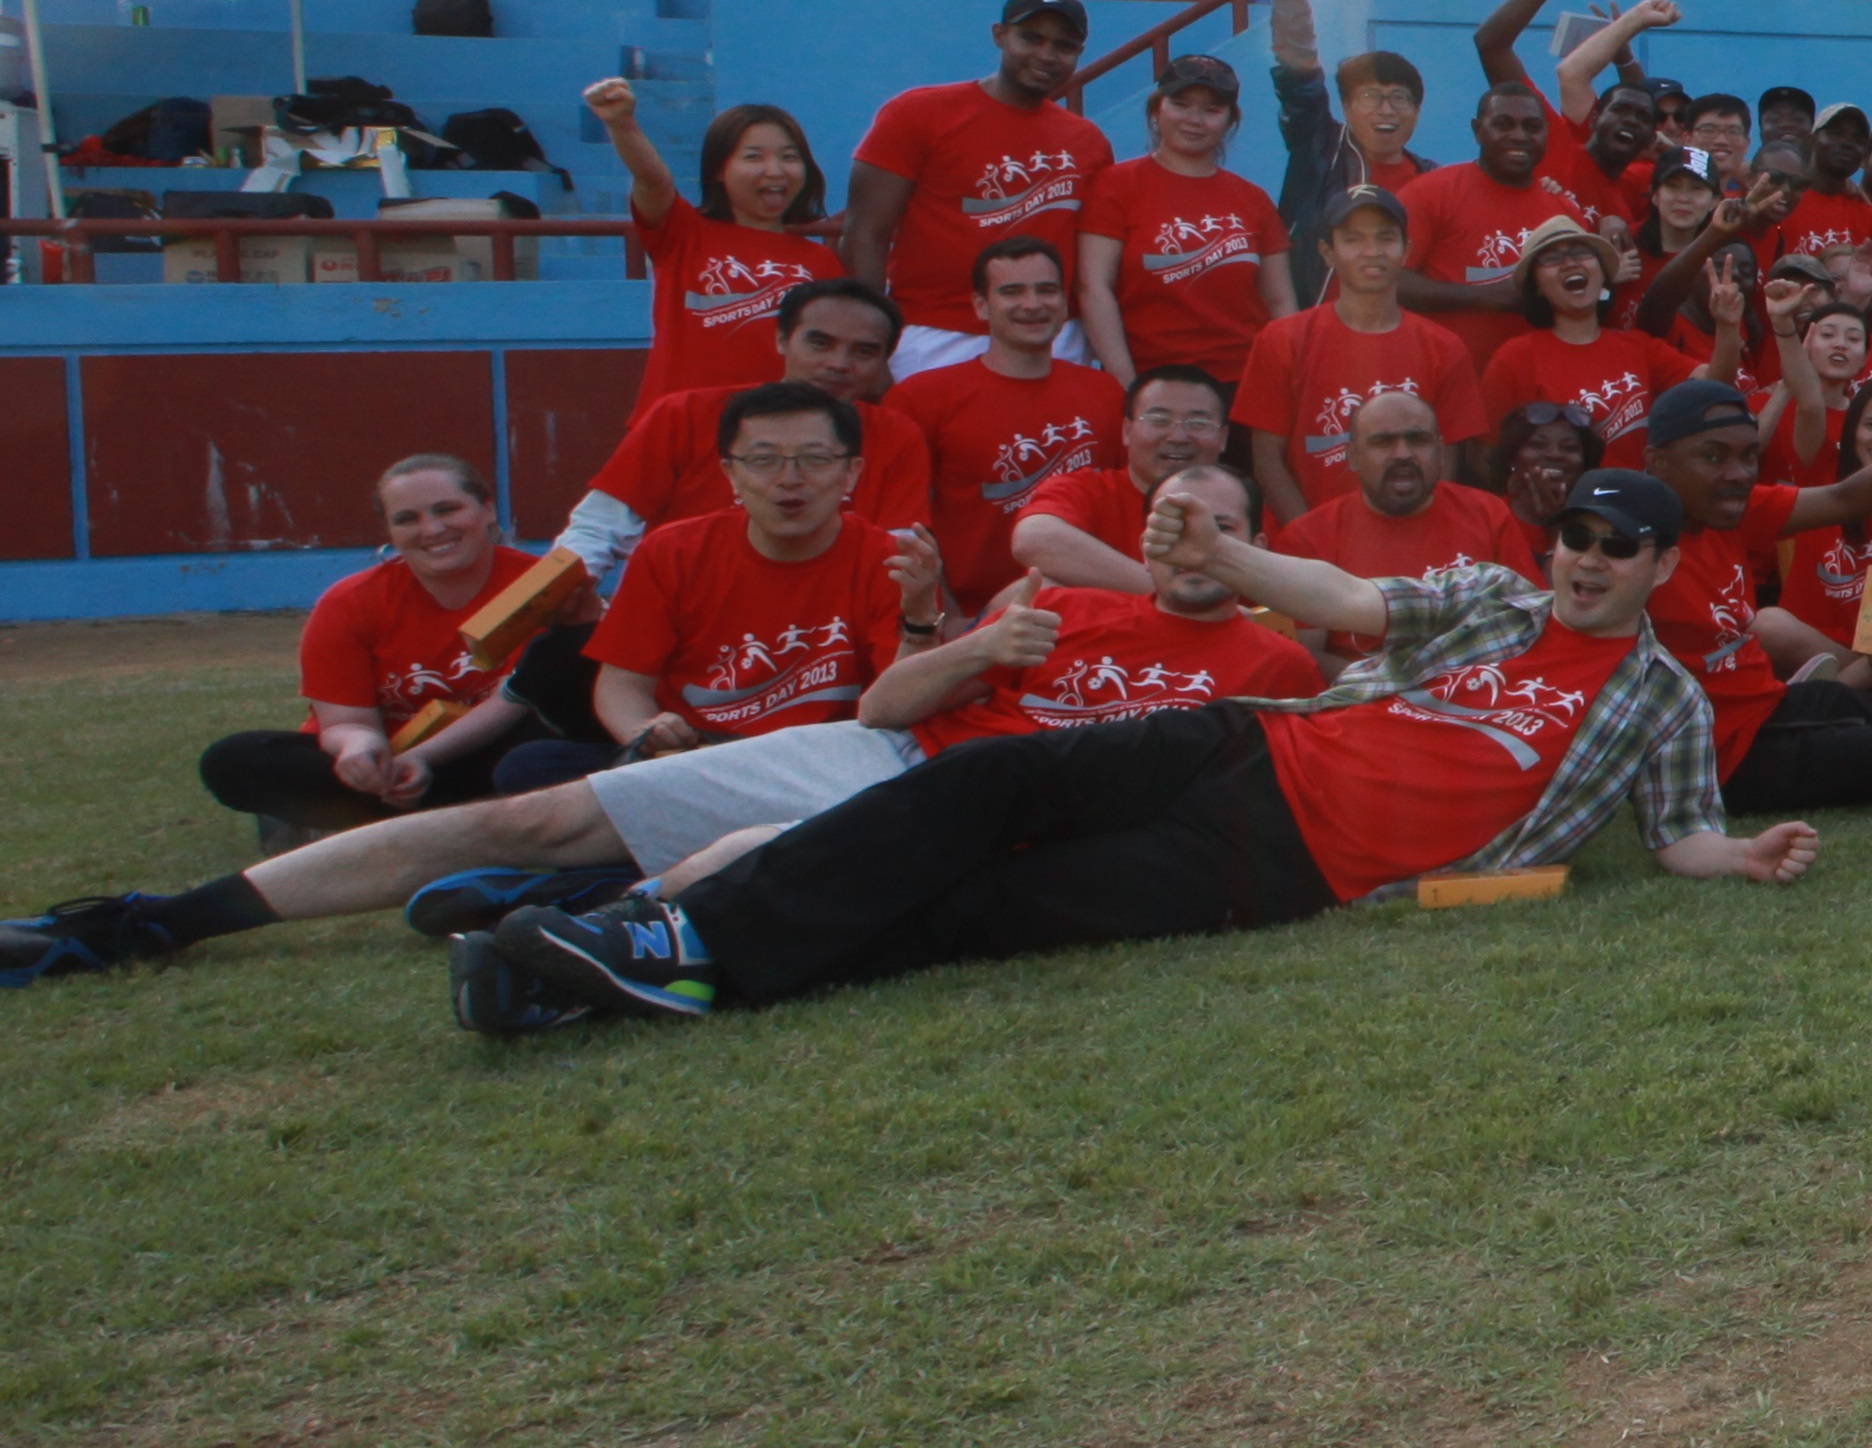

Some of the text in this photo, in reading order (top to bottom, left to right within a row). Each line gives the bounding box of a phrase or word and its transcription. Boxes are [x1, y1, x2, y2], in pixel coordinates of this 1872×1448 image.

[979, 181, 1074, 228] SPORTS DAY 2013
[1162, 237, 1249, 284] SPORTS DAY 2013
[703, 307, 753, 328] SPORTS
[752, 297, 774, 315] DAY
[1606, 399, 1644, 439] DAY 2013
[1067, 449, 1092, 473] 2013
[766, 683, 797, 708] DAY
[801, 660, 837, 690] 2013
[1496, 710, 1545, 737] 2013
[622, 920, 672, 959] N
